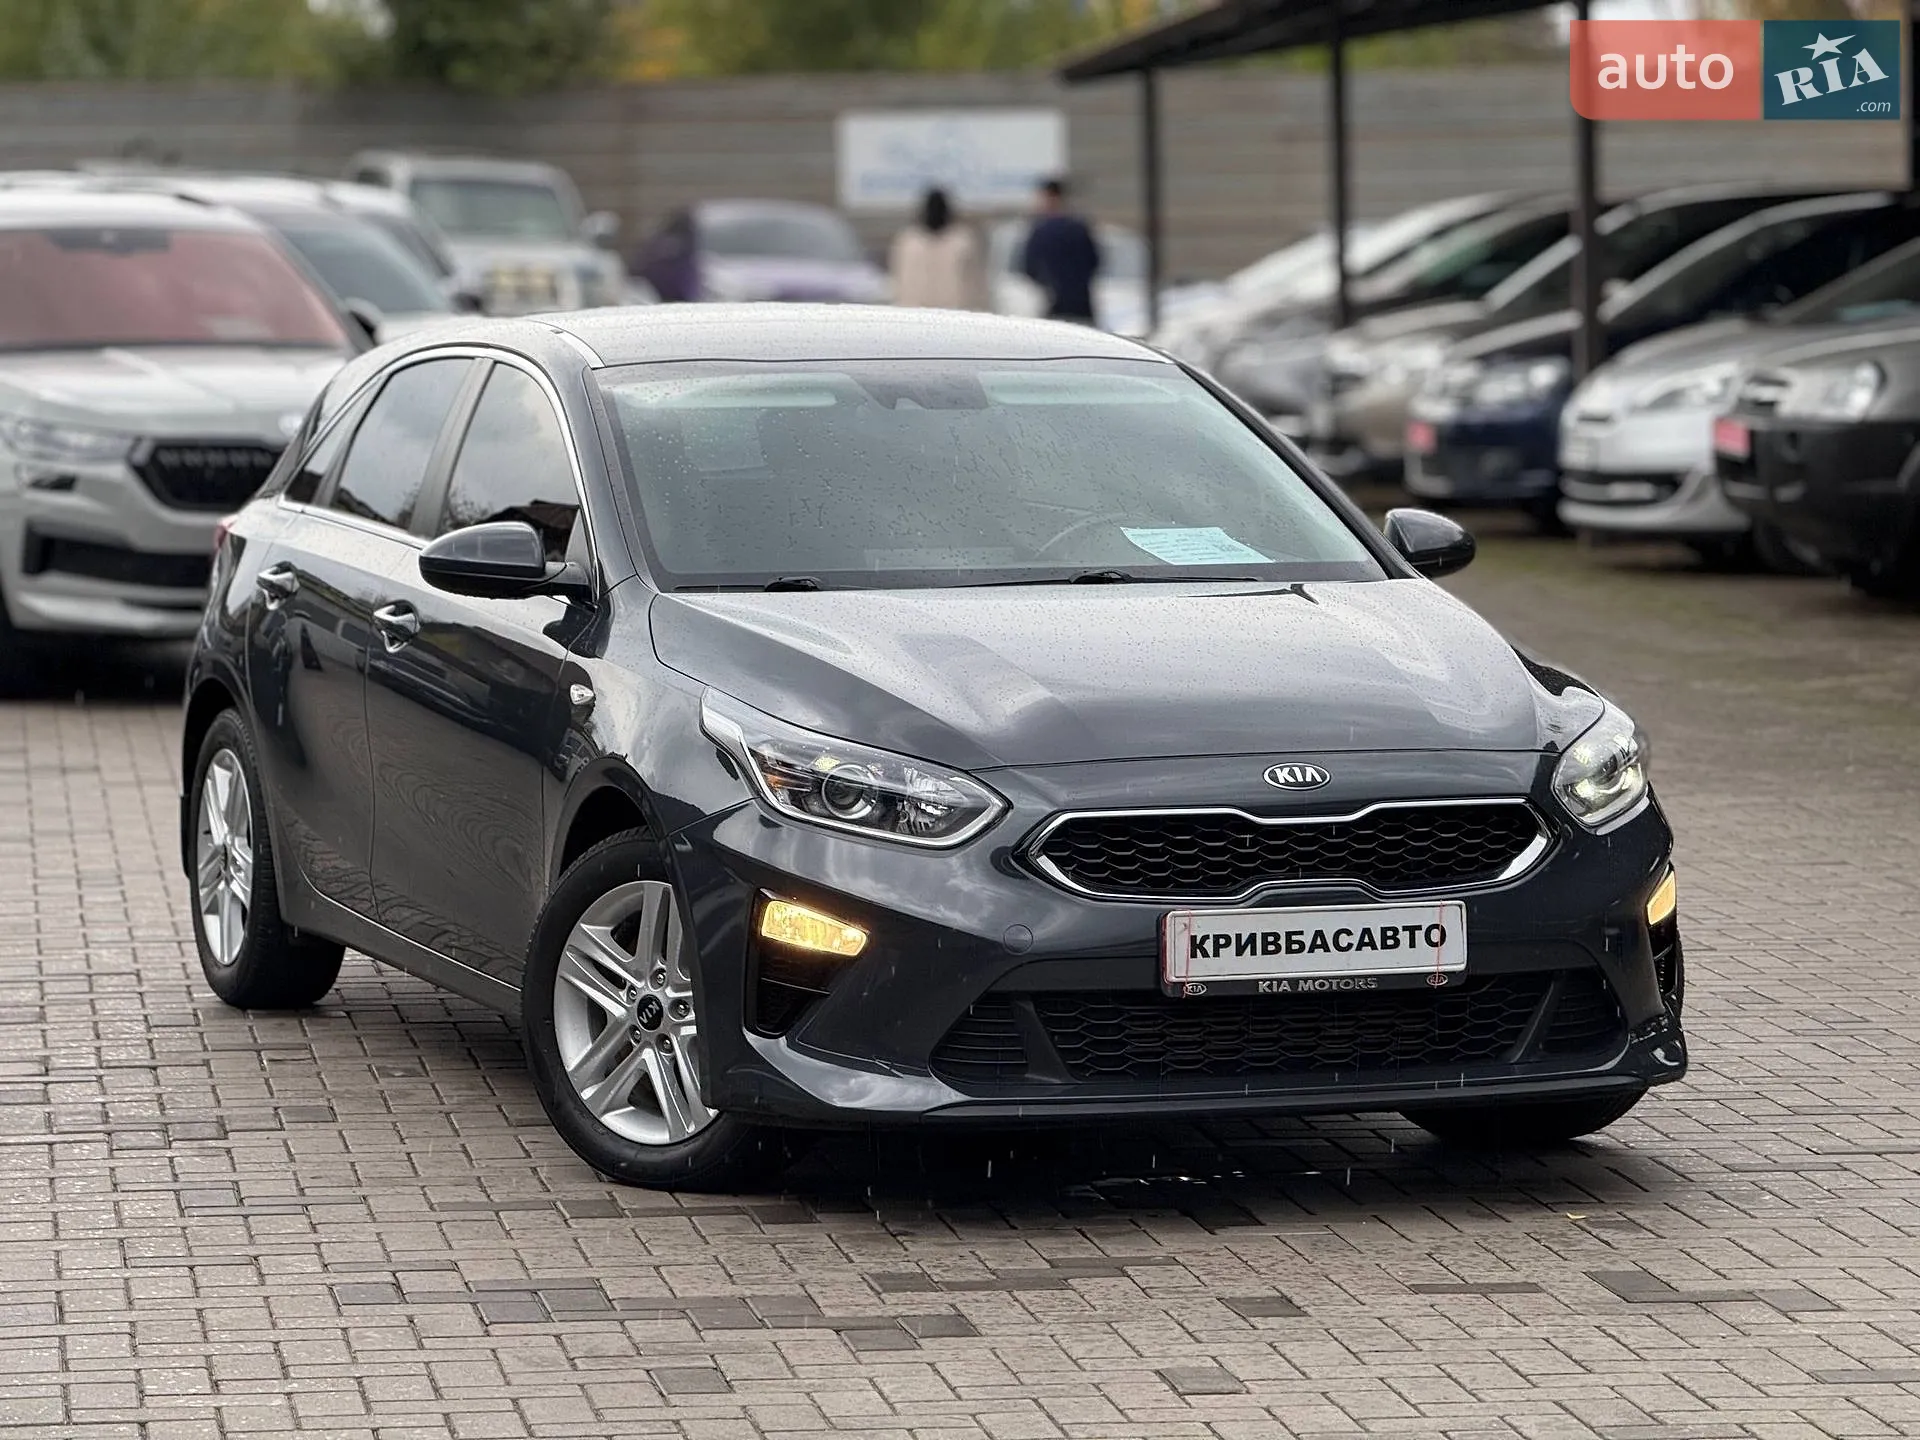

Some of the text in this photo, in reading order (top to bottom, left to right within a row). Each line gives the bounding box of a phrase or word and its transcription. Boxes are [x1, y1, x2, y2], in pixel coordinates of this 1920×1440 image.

[1274, 766, 1323, 784] KIA
[1190, 923, 1447, 959] КРИВБАСАВТО
[1258, 977, 1378, 993] KIA MOTORS
